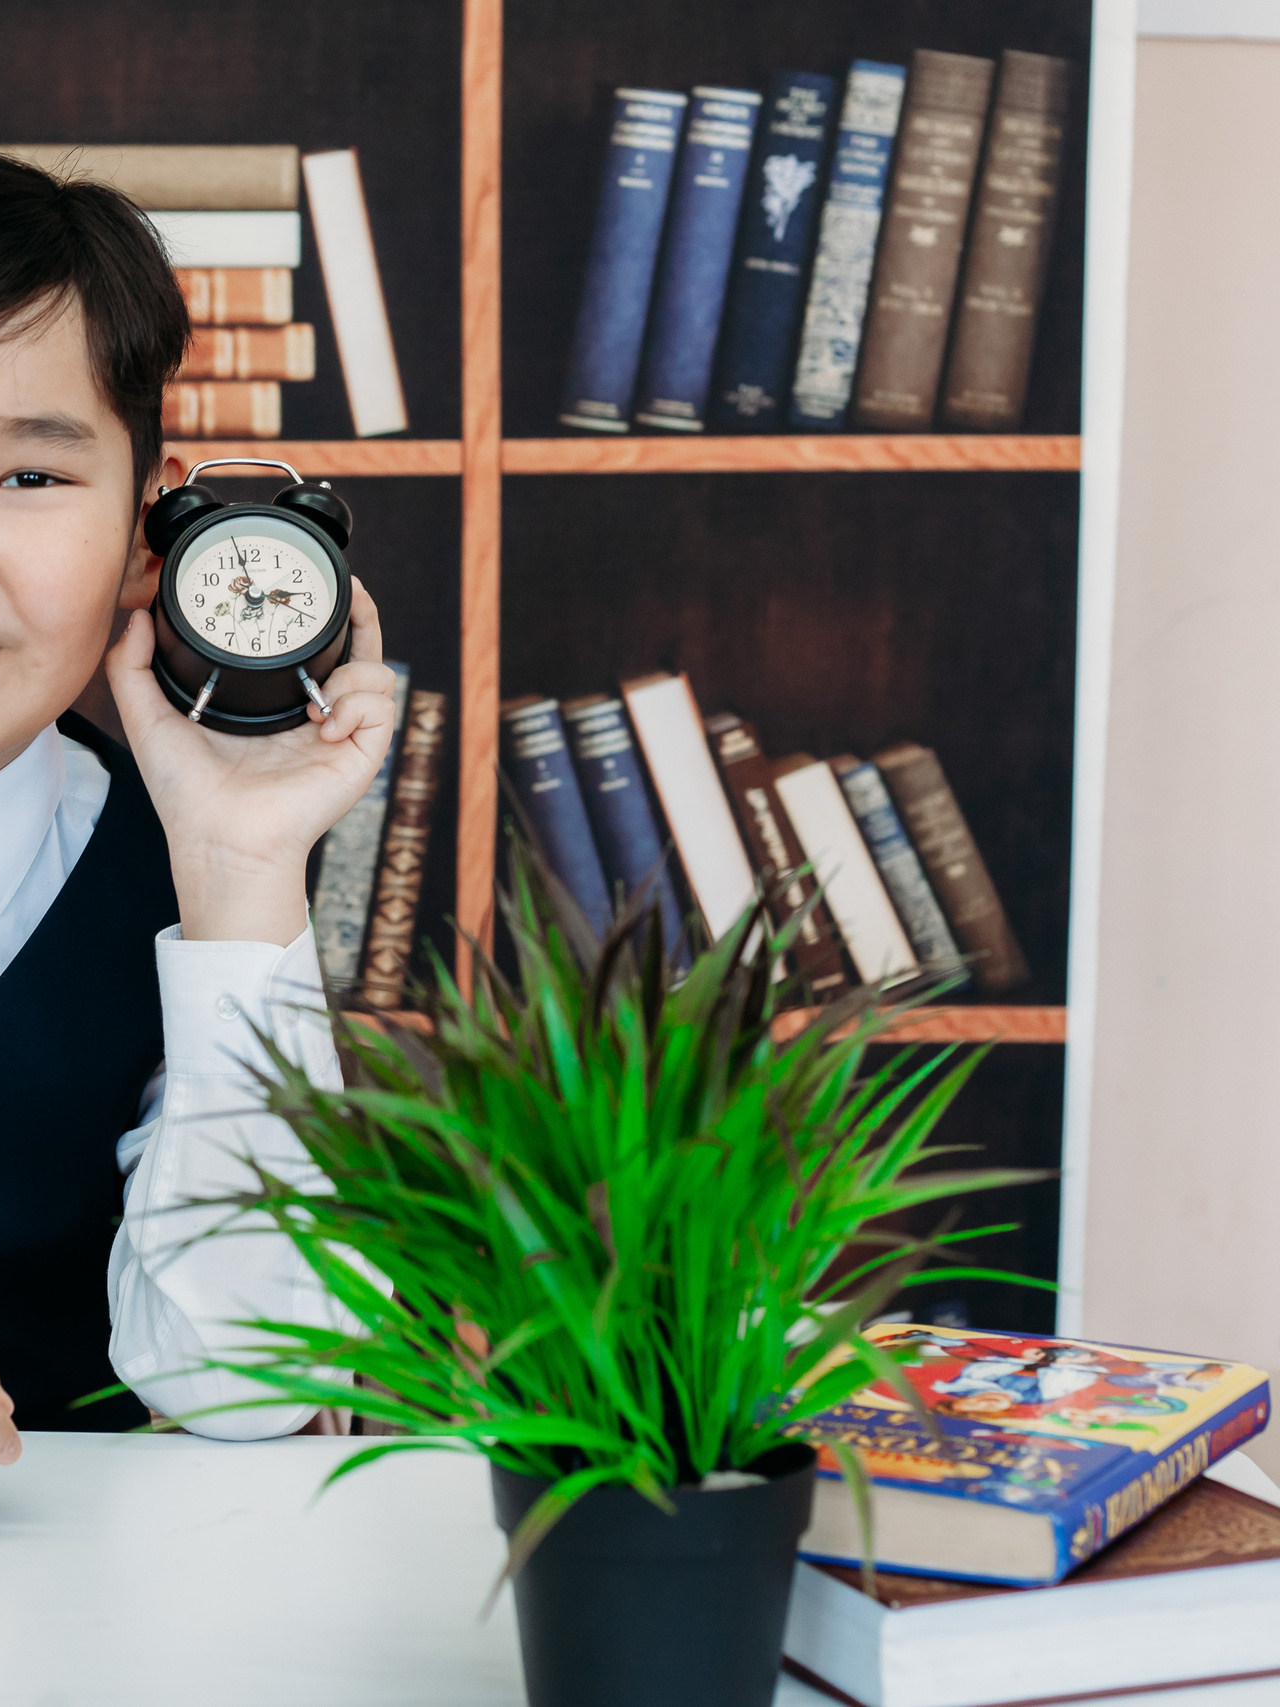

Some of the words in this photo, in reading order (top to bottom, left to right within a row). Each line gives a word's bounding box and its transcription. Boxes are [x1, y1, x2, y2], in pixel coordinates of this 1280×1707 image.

[218, 556, 236, 570] 11
[241, 549, 261, 563] 12
[274, 555, 282, 569] 1
[202, 573, 220, 587] 10
[292, 569, 303, 583] 2
[194, 594, 205, 608] 9
[303, 592, 314, 606] 3
[205, 617, 216, 631] 8
[294, 613, 305, 628] 4
[224, 632, 235, 647] 7
[251, 638, 261, 652] 6
[277, 631, 288, 645] 5
